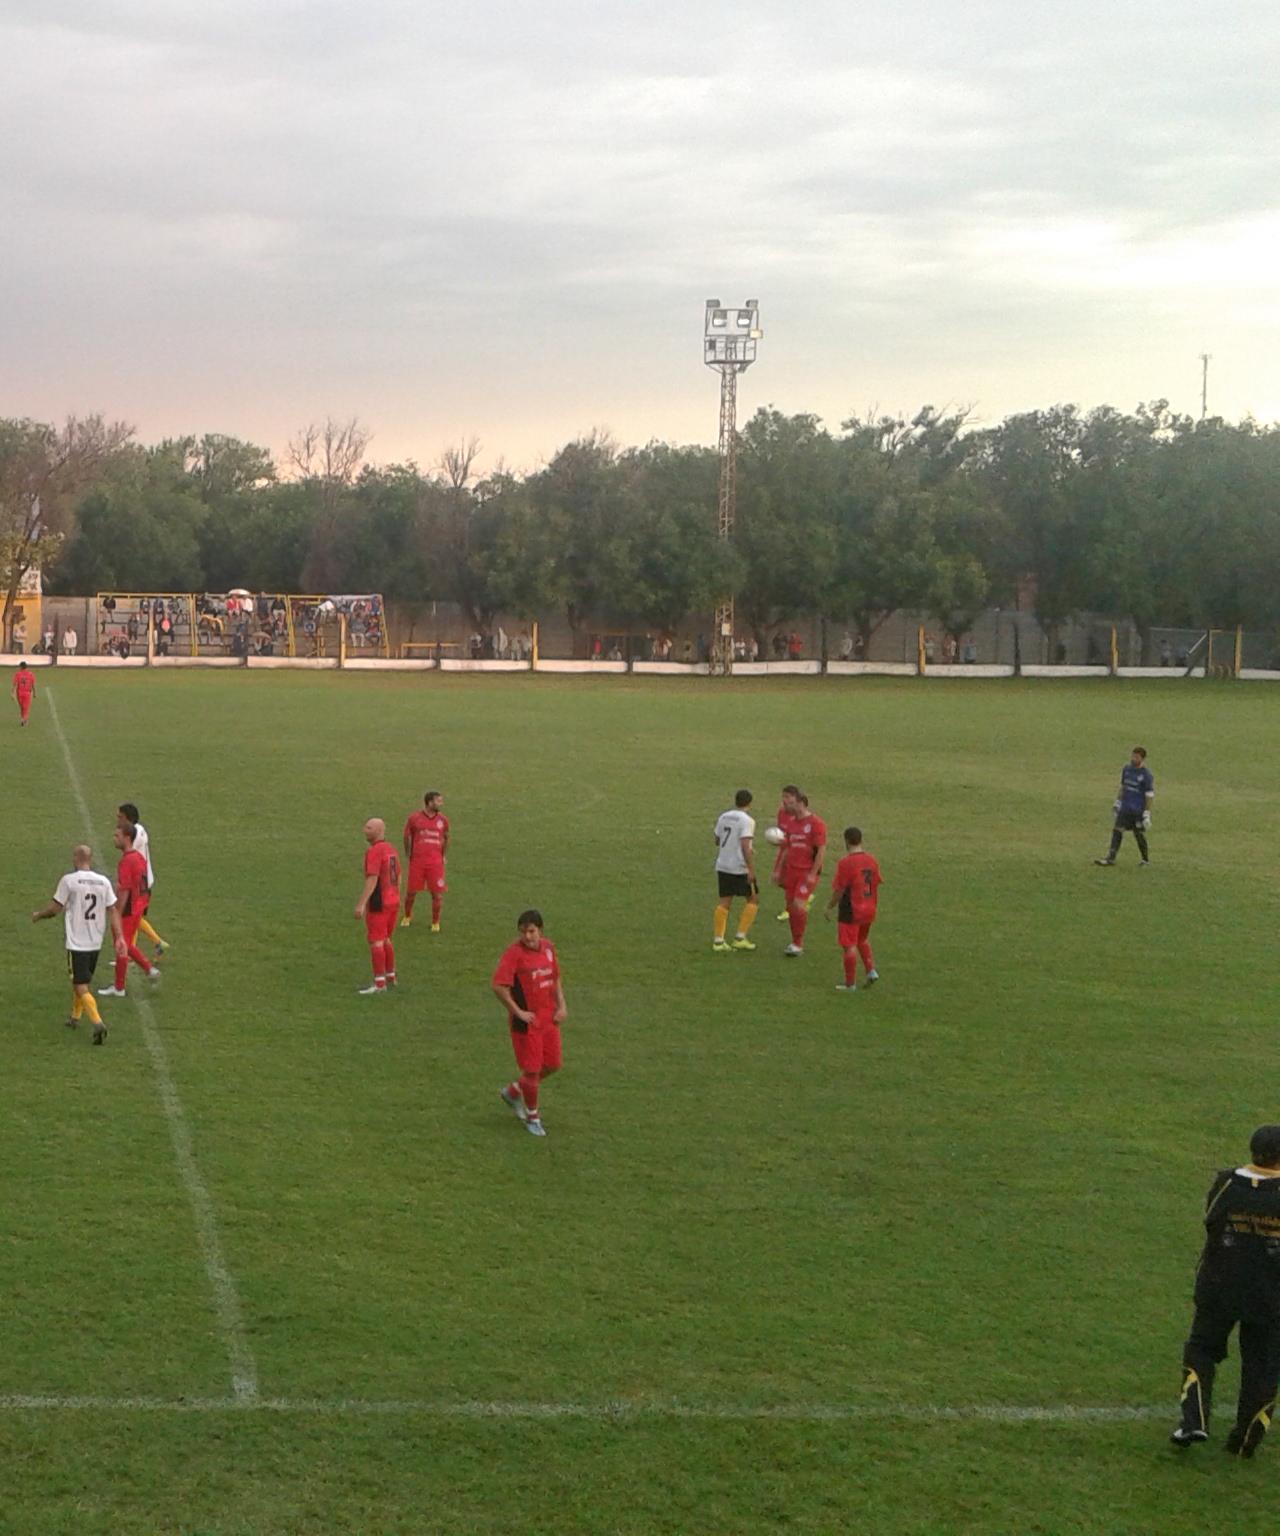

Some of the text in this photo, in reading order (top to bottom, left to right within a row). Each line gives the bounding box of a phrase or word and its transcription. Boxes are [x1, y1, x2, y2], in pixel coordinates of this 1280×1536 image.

[722, 826, 732, 848] 7
[861, 869, 873, 898] 3
[84, 893, 97, 920] 2
